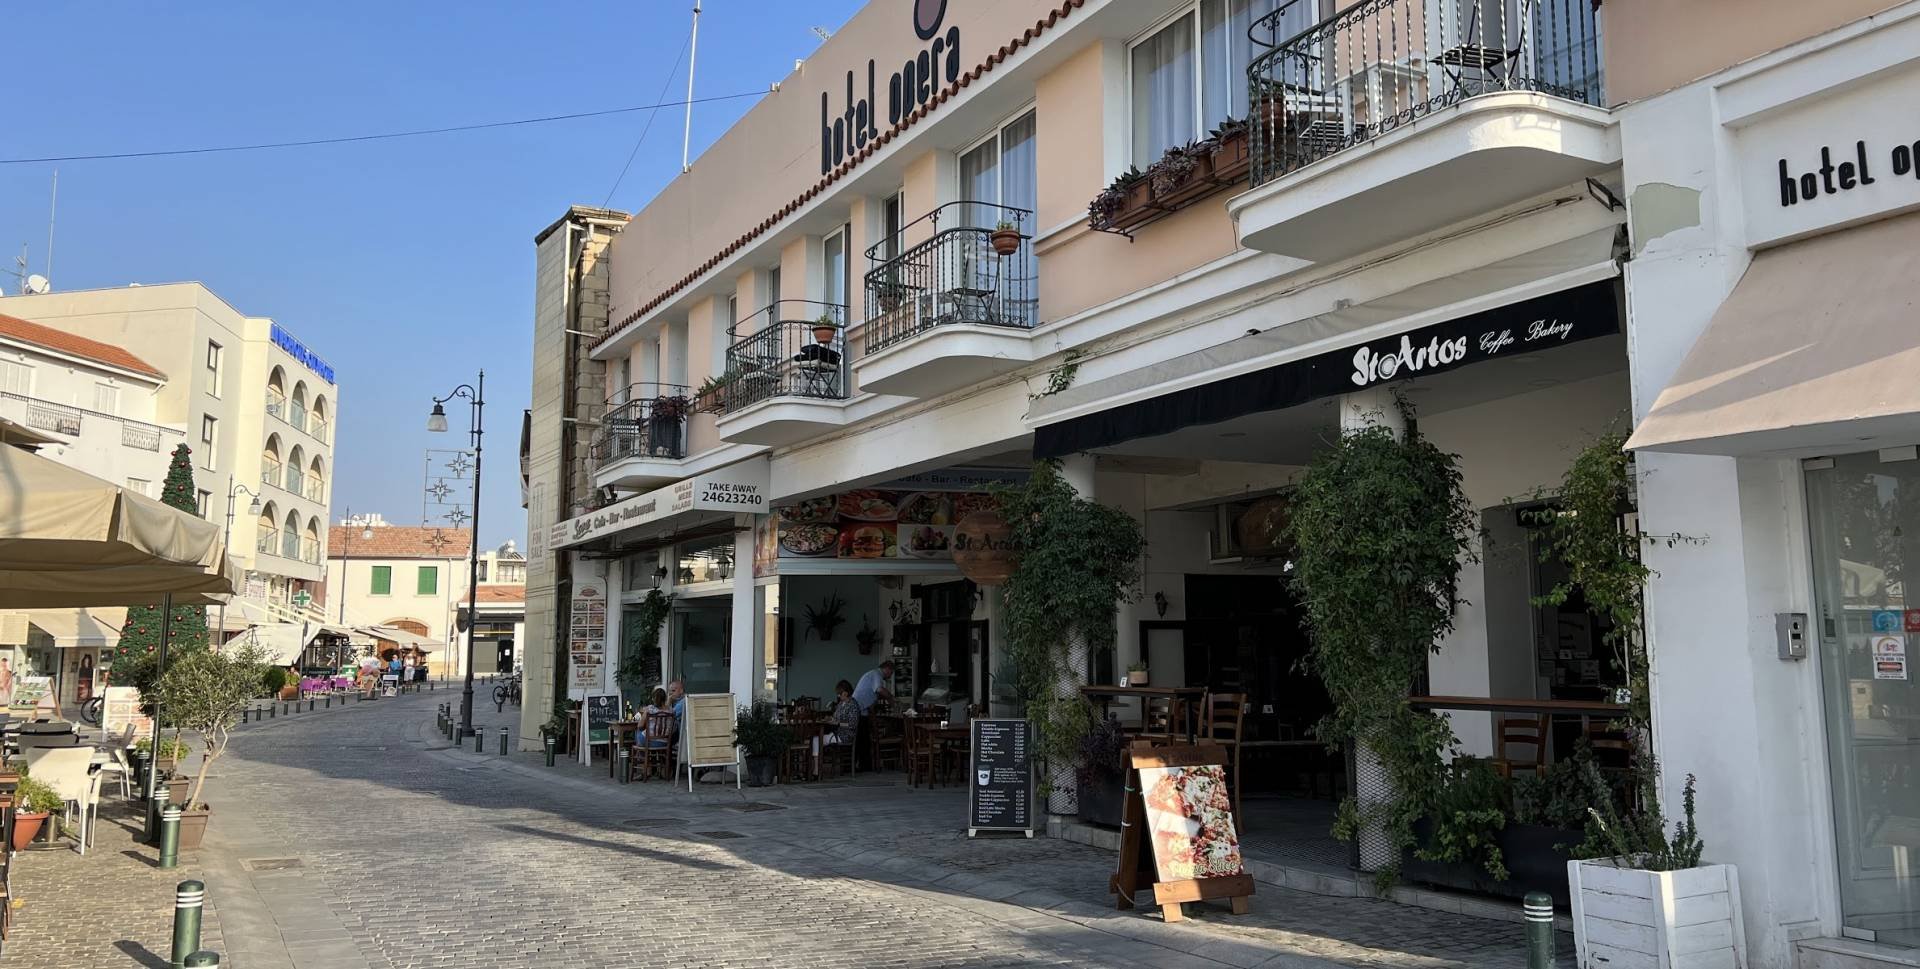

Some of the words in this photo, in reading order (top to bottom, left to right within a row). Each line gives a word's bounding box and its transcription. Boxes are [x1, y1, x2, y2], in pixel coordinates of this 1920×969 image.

[821, 59, 878, 175] hotel
[889, 26, 960, 125] opera
[1778, 140, 1876, 207] hotel
[1479, 328, 1514, 354] Coffee
[1525, 321, 1573, 347] Bakery
[702, 492, 762, 505] 24623240
[708, 483, 731, 492] TAKE
[733, 484, 757, 493] AWAY
